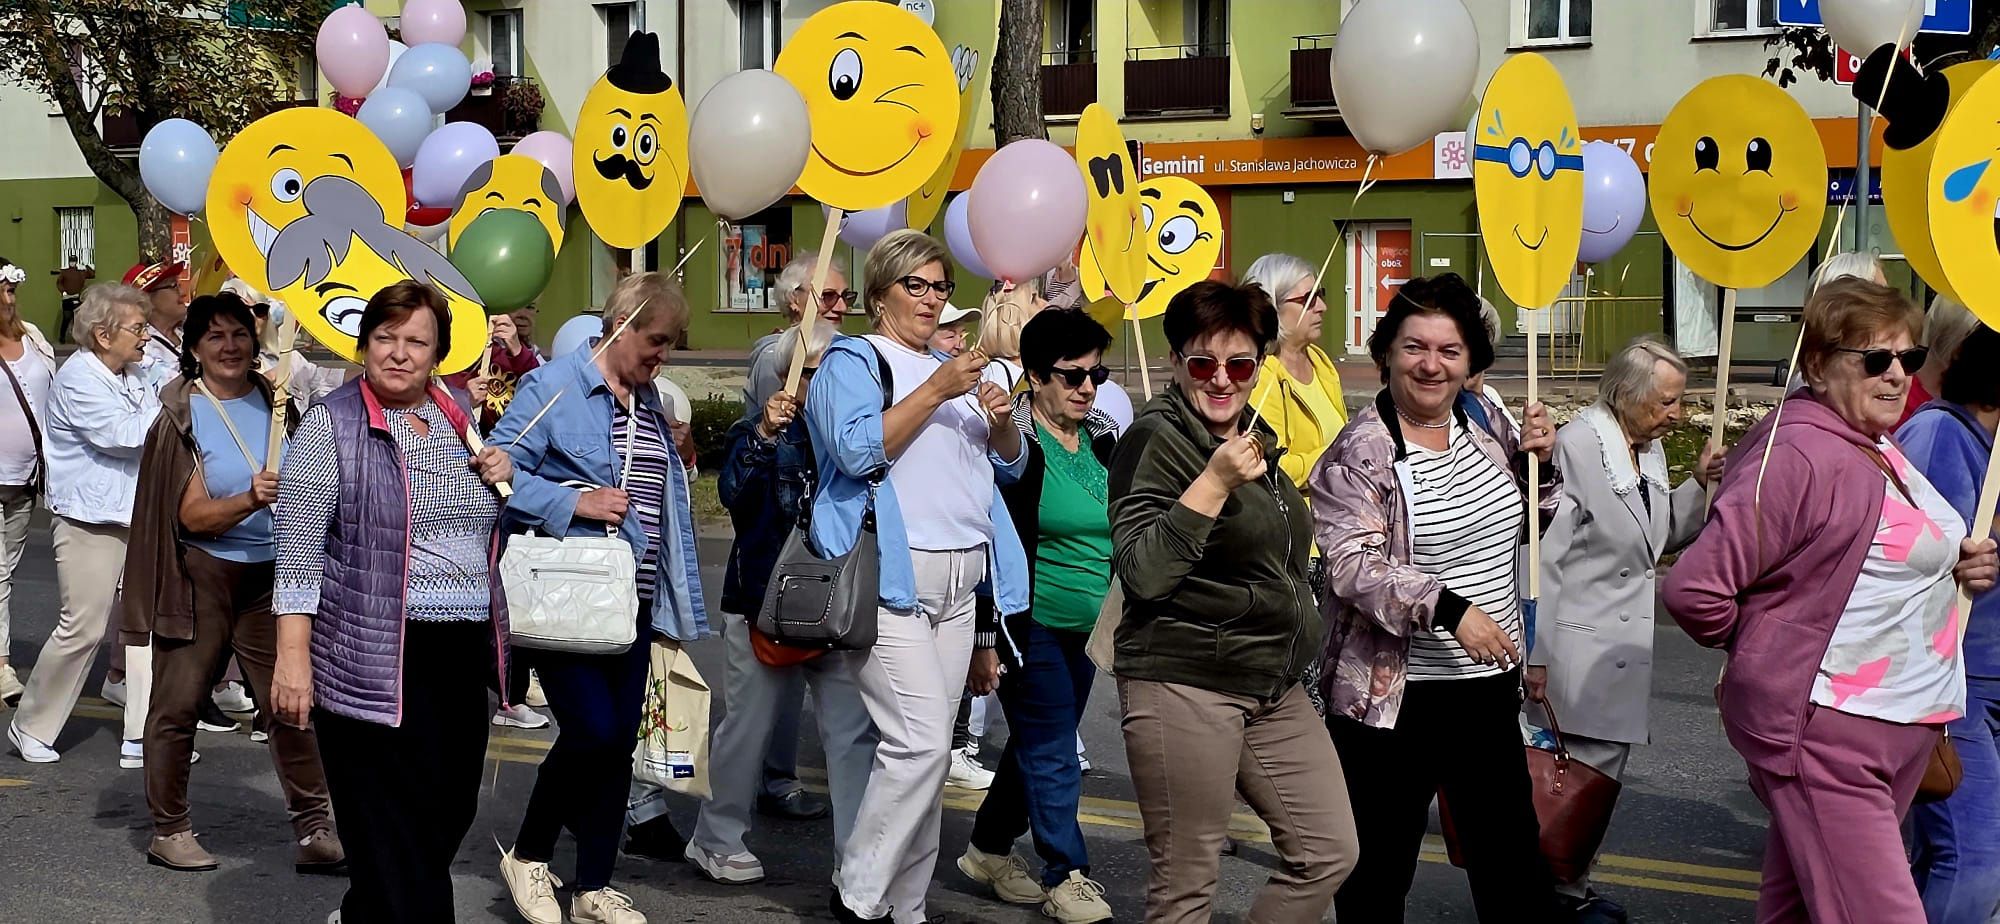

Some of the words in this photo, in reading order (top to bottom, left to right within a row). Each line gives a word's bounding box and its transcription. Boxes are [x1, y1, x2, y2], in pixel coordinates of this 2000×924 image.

[906, 2, 925, 11] nc+
[1142, 155, 1205, 174] Gemini
[1214, 159, 1229, 172] ul.
[1292, 156, 1357, 174] Jachowicza
